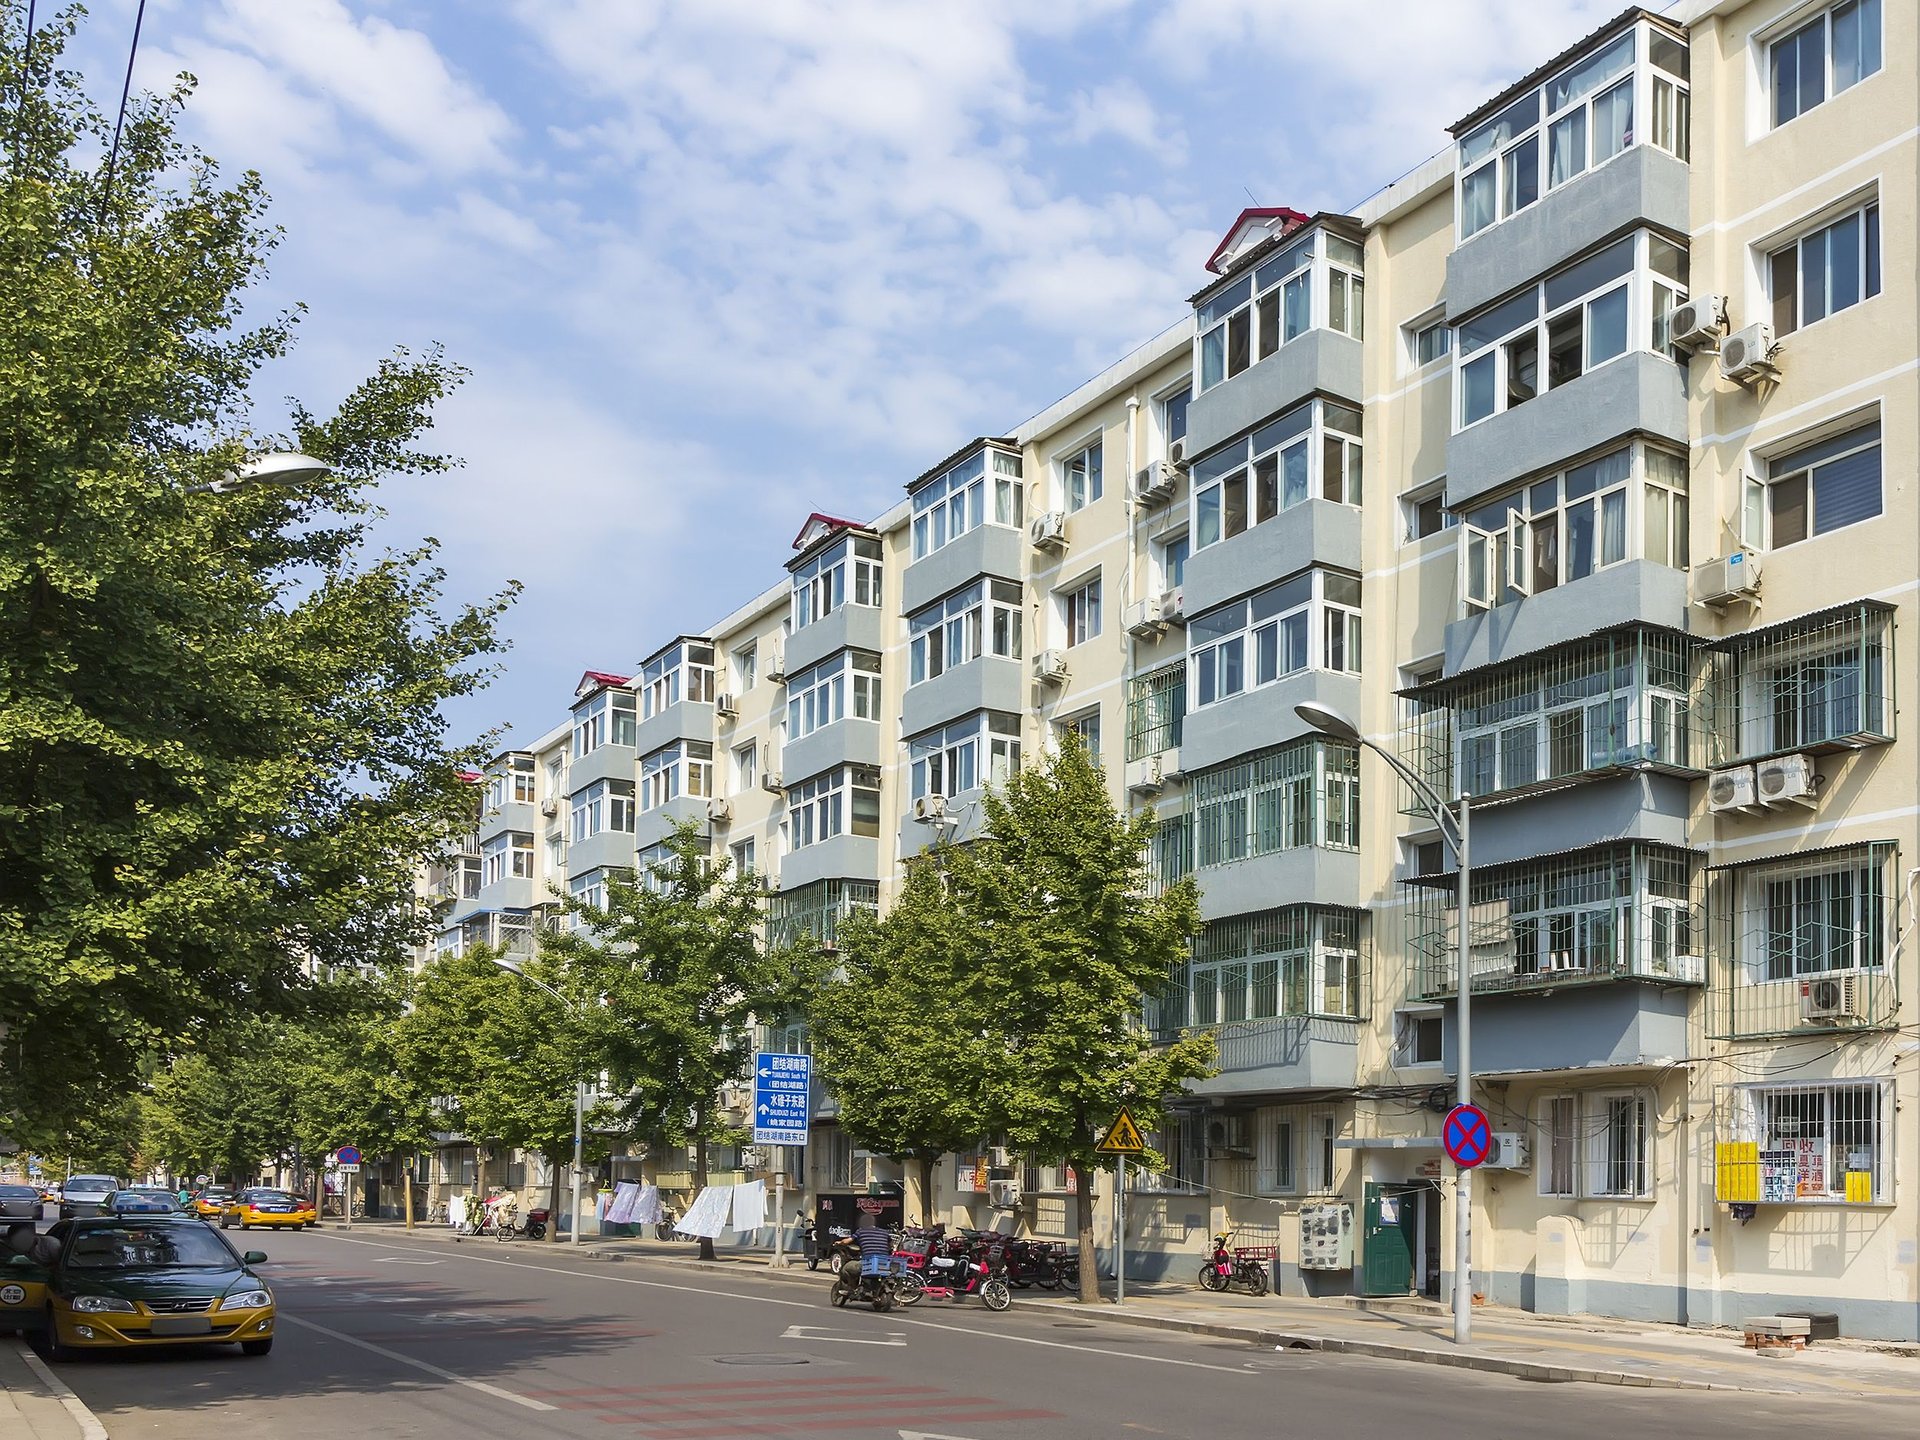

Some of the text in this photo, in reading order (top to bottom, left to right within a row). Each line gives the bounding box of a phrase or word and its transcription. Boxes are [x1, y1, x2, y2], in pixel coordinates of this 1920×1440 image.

[772, 1057, 807, 1072] 团结湖南路
[770, 1094, 805, 1108] 水碓子东路
[756, 1130, 805, 1142] 团结湖南路东口
[1782, 1138, 1815, 1153] 回收
